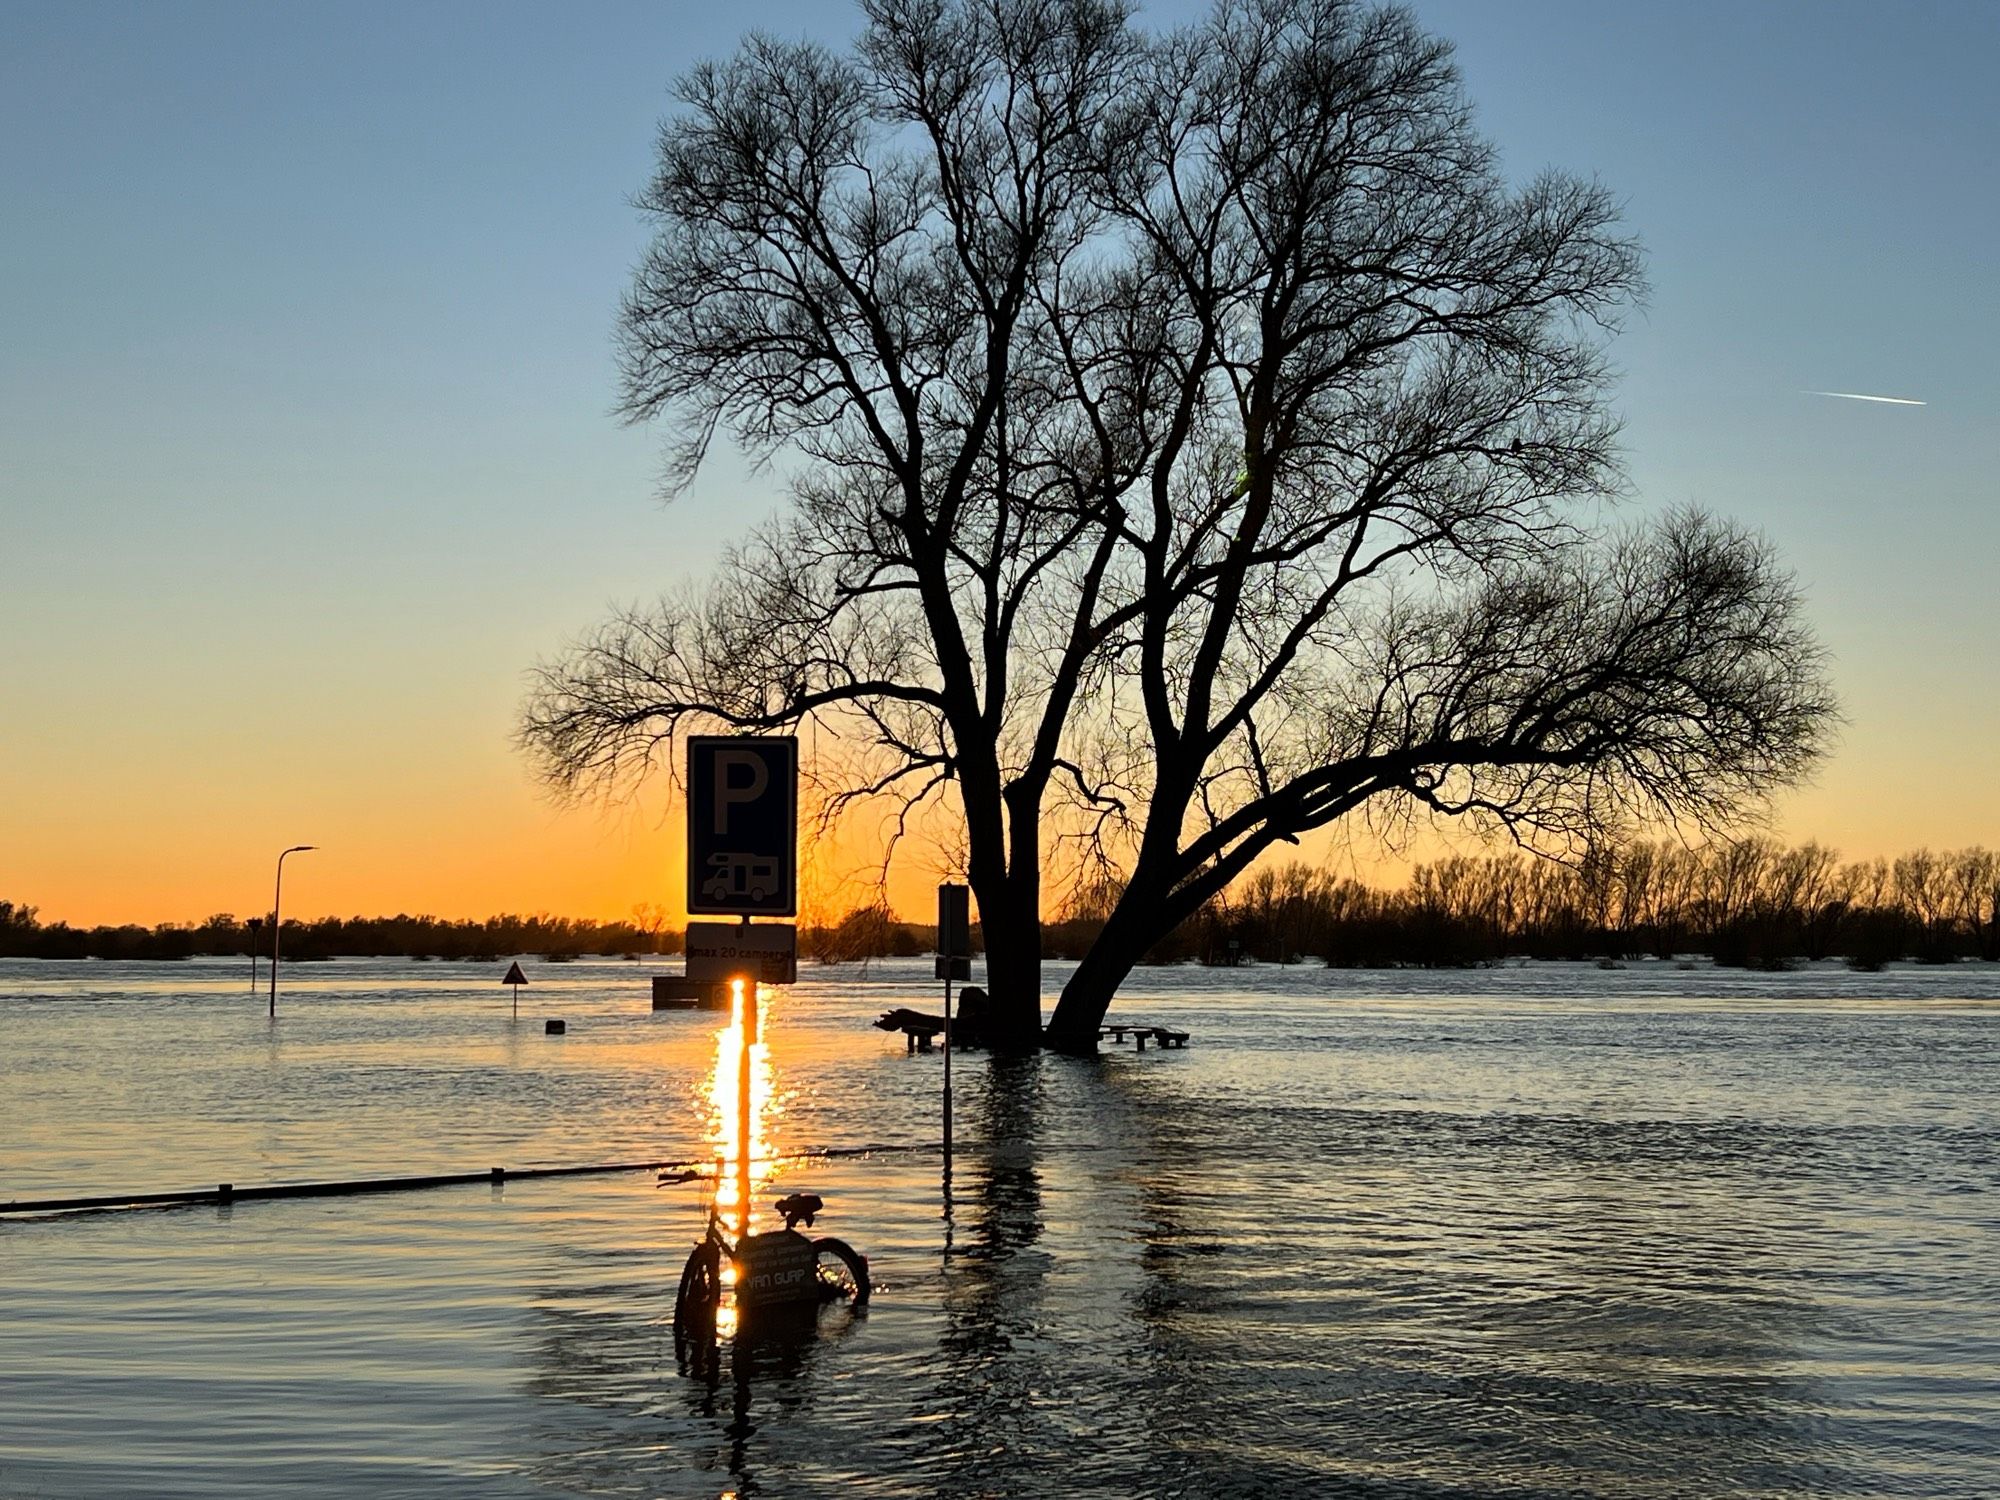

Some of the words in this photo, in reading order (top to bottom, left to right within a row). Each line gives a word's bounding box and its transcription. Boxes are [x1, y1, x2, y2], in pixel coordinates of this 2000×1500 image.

[714, 750, 769, 835] P
[694, 948, 718, 958] max
[721, 946, 736, 959] 20
[738, 948, 787, 960] campers
[747, 1273, 772, 1289] VAN
